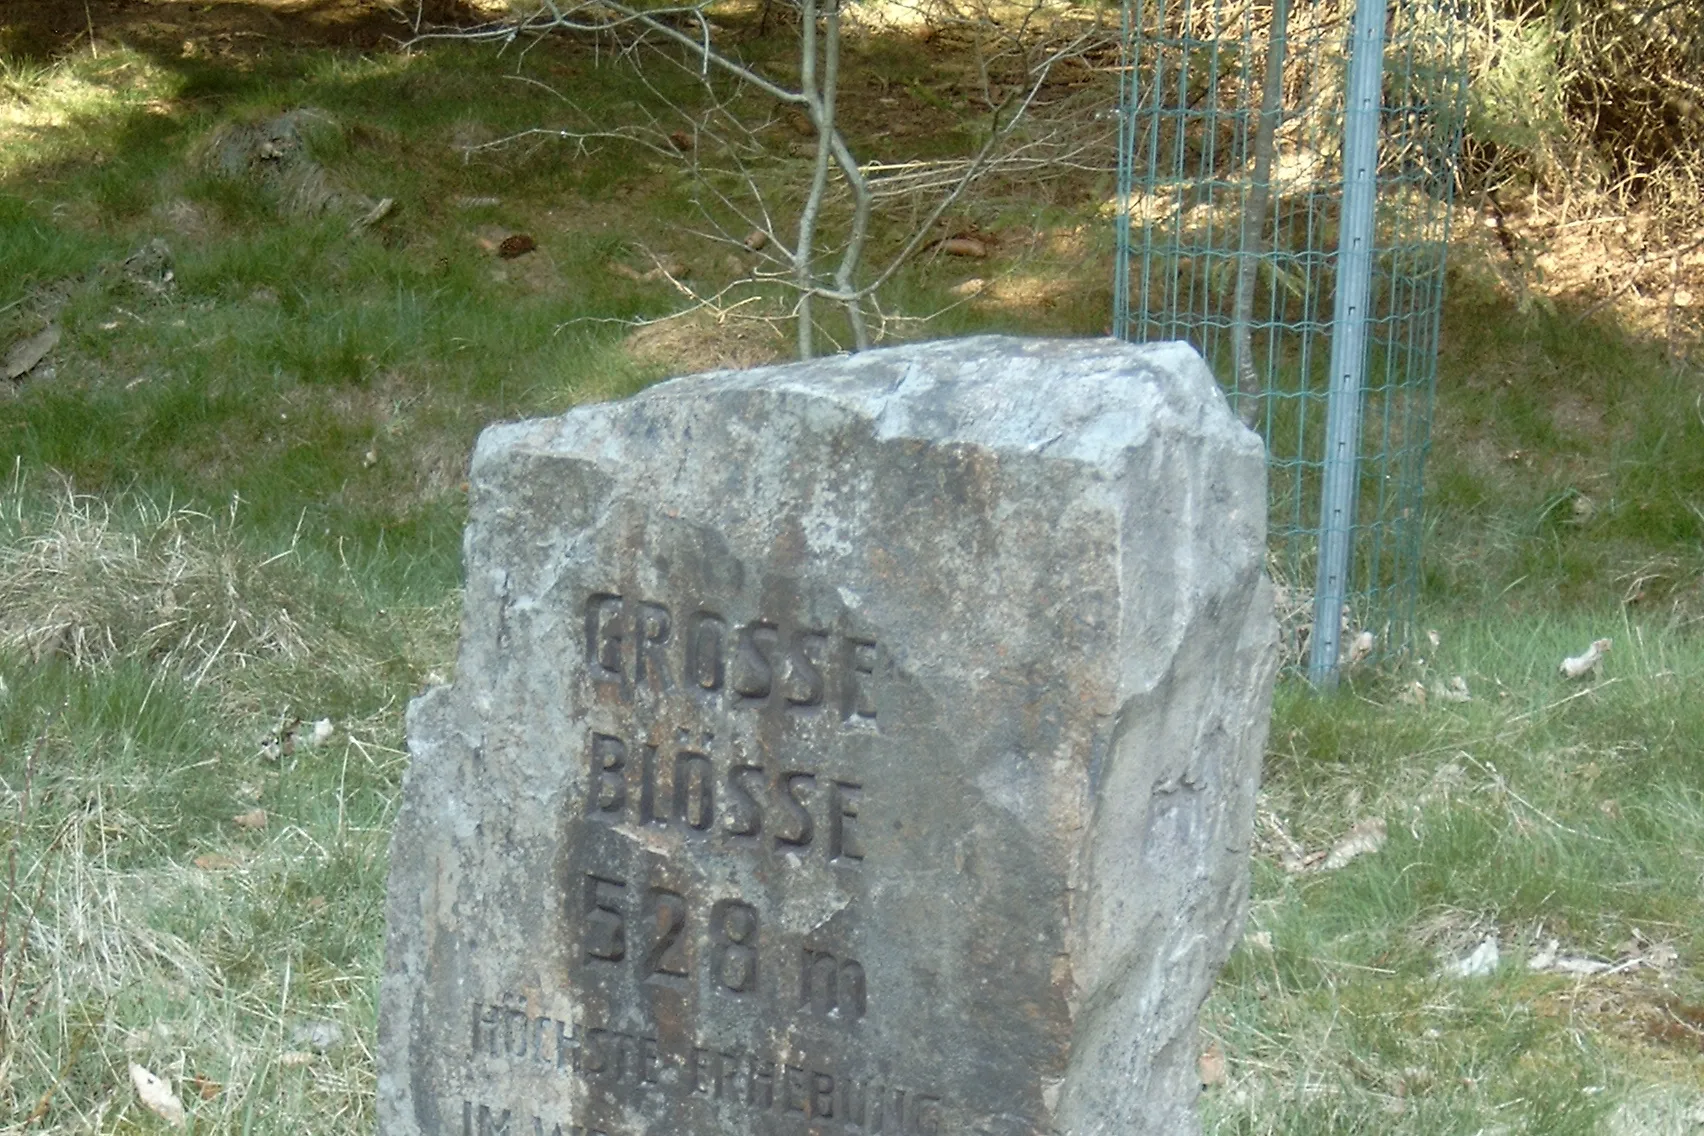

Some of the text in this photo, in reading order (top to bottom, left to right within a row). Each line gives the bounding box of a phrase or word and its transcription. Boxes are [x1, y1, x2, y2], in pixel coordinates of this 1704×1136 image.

[585, 592, 878, 720] GROSSE
[585, 727, 864, 862] BLÖSSE
[582, 871, 868, 1020] 528 m
[472, 990, 658, 1088] HÖCHSTE
